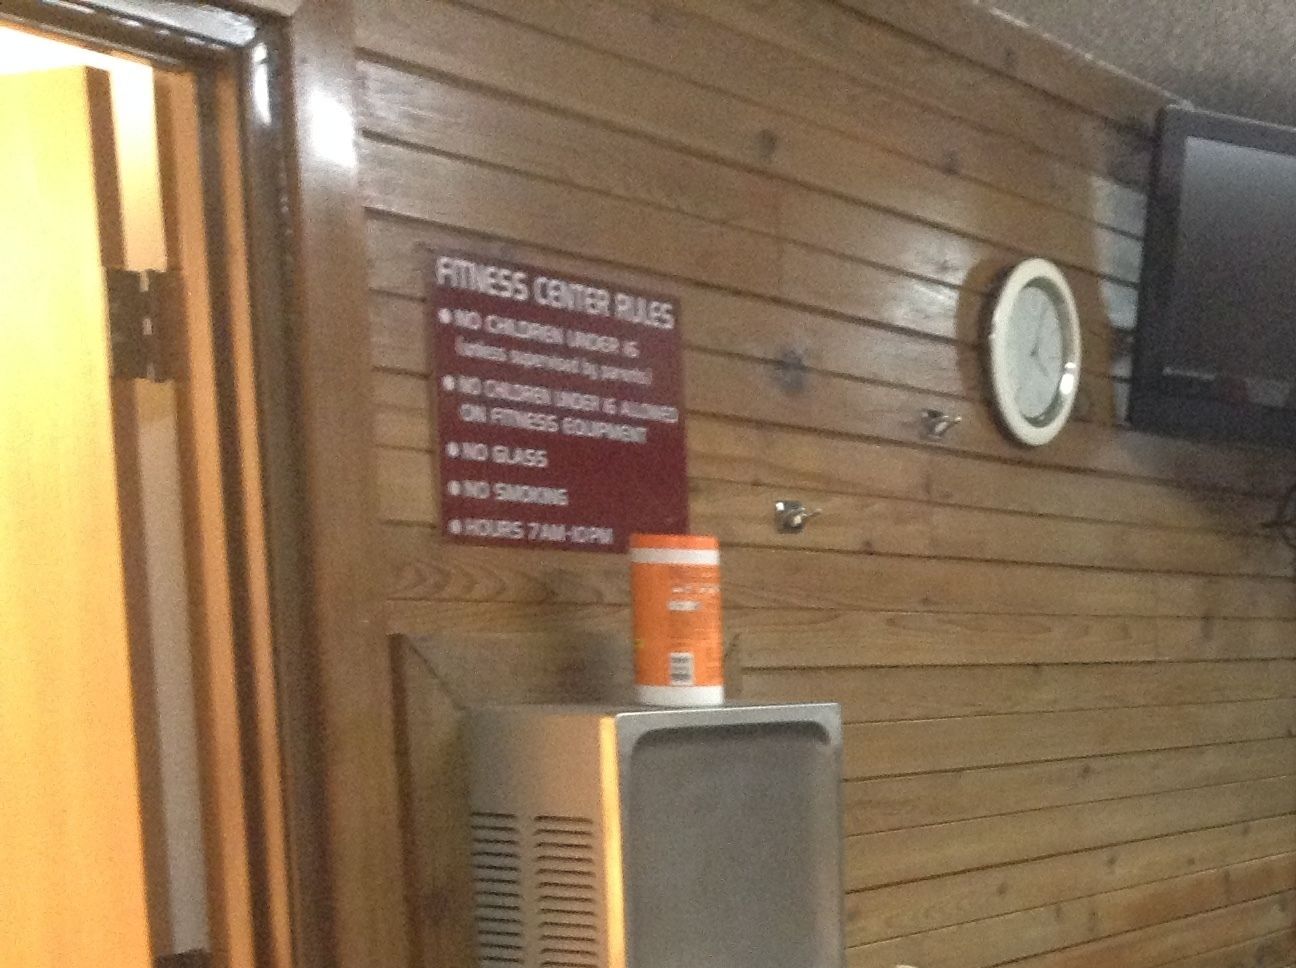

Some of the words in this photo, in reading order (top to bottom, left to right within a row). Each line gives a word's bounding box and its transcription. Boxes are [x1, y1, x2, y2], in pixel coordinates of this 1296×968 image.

[435, 256, 529, 300] FITNESS
[533, 276, 611, 317] CENTER
[613, 292, 675, 330] RULES
[454, 308, 482, 331] NO
[484, 314, 564, 345] CHILDREN
[565, 329, 620, 354] UNDER
[456, 374, 482, 395] NO
[483, 379, 551, 403] CHILDREN
[552, 390, 599, 412] UNDER
[619, 400, 679, 424] ALLOWED
[460, 403, 487, 423] ON
[490, 407, 560, 433] FITNESS
[562, 416, 647, 444] EQUIPMENT
[461, 441, 488, 462] NO
[491, 445, 548, 468] GLASS
[462, 479, 490, 499] NO
[494, 482, 569, 506] SMOKING
